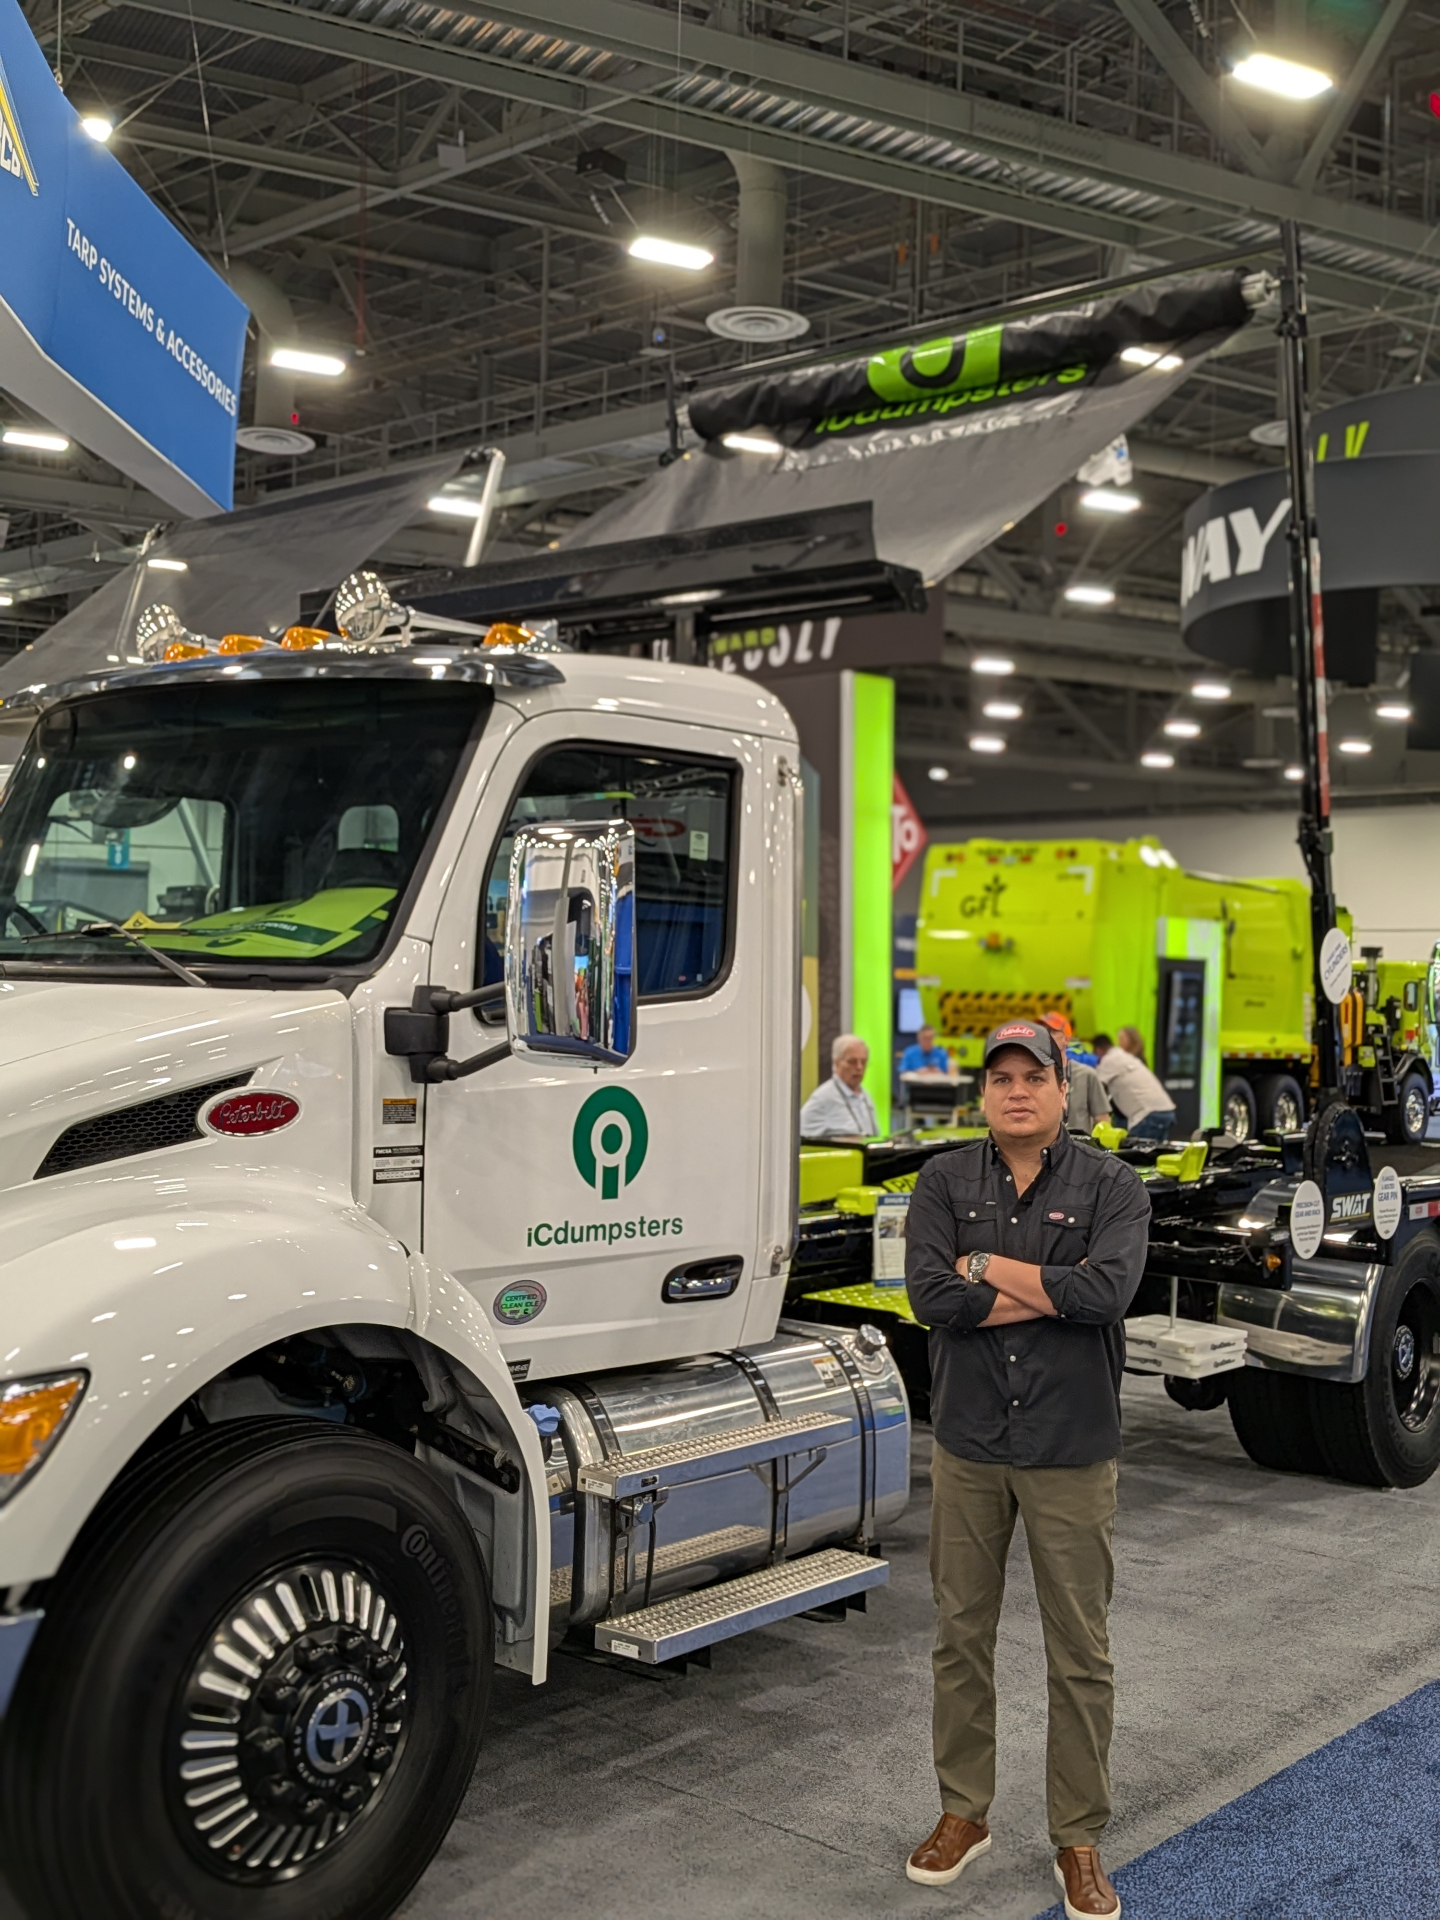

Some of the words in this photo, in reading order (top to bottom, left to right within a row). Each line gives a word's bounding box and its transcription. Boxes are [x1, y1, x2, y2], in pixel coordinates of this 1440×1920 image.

[67, 217, 98, 271] TARP
[99, 257, 155, 333] SYSTEMS
[156, 318, 166, 343] &
[166, 329, 237, 417] ACCESSORIES
[219, 1100, 291, 1127] Peterbilt
[1331, 1193, 1371, 1218] SWAT
[526, 1215, 684, 1247] iCdumpsters
[501, 1301, 523, 1310] CLEAN
[525, 1300, 540, 1308] IDLE
[505, 1294, 538, 1302] CERTIFIED
